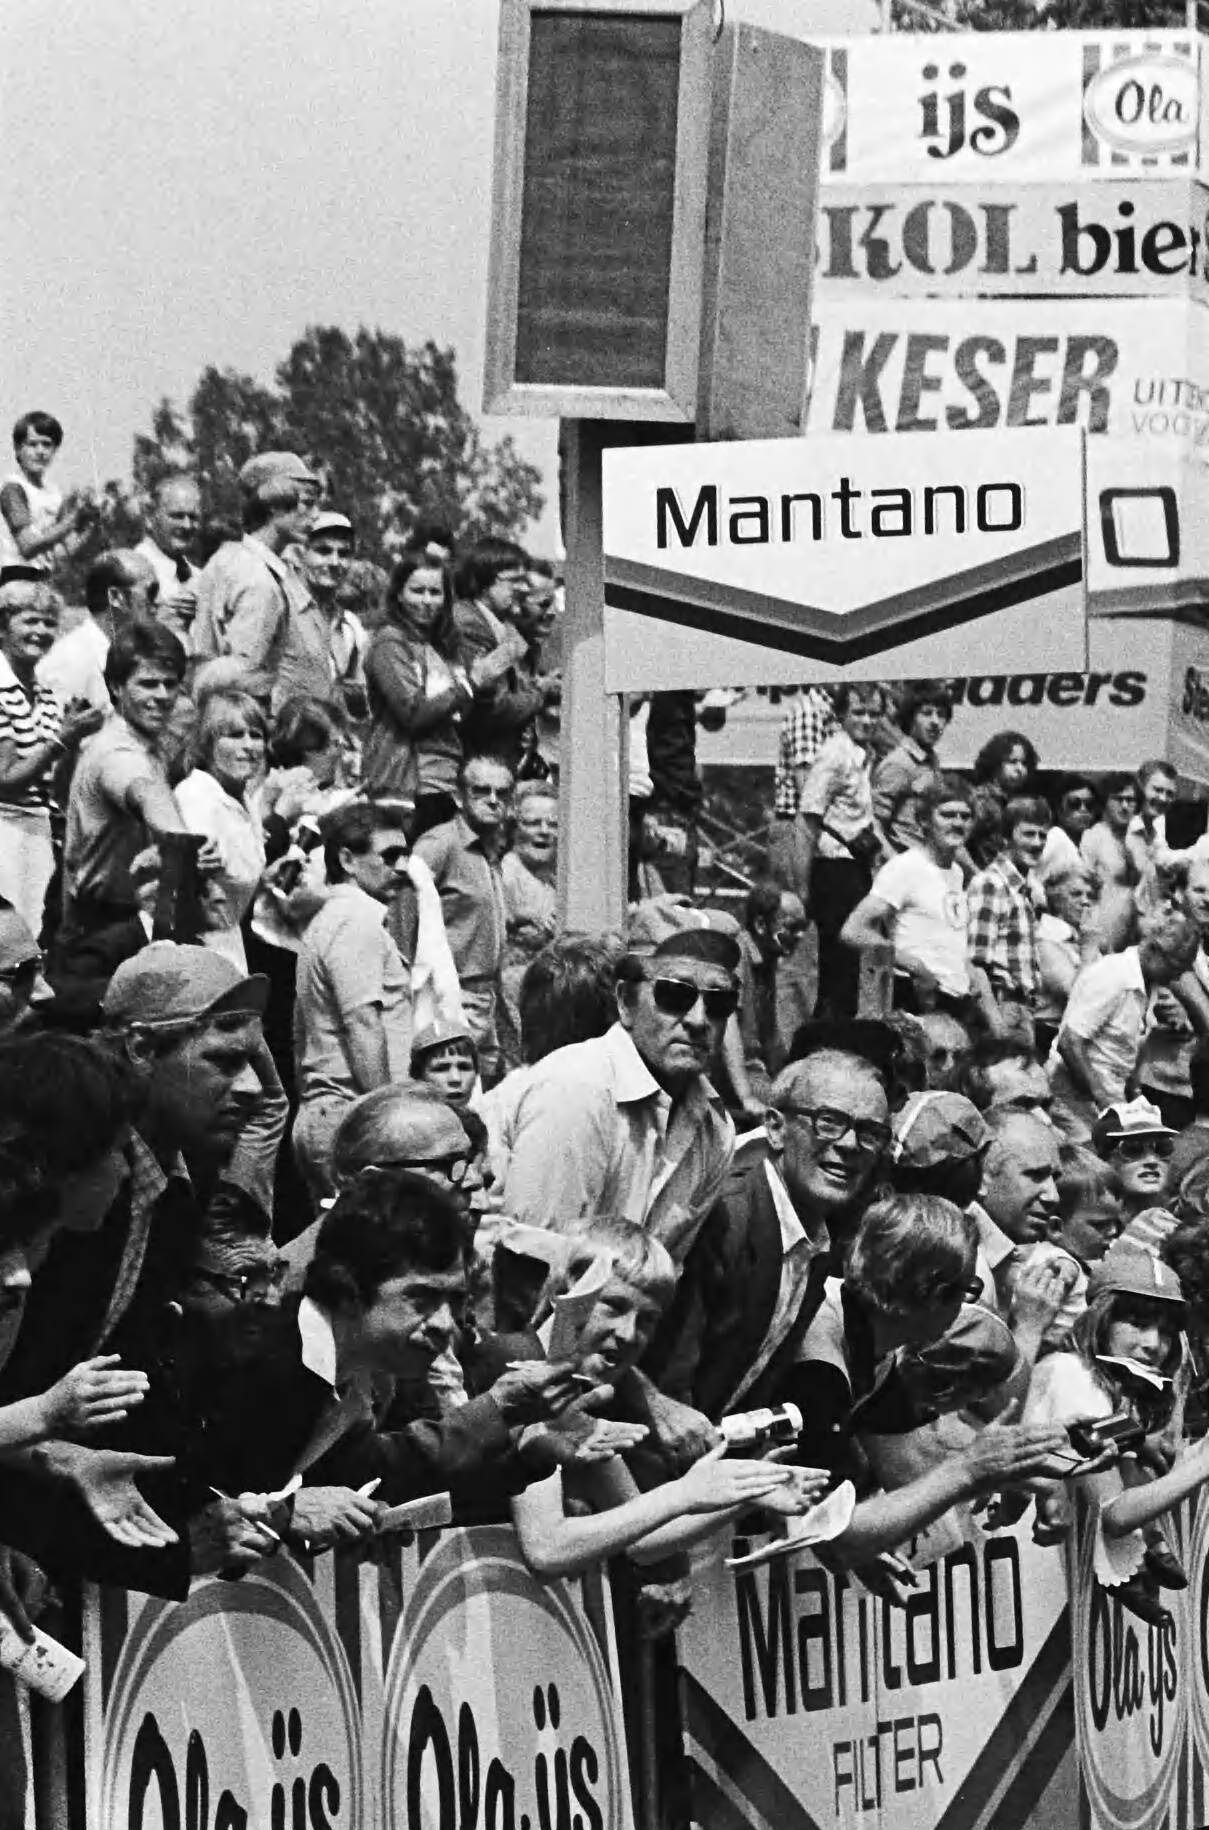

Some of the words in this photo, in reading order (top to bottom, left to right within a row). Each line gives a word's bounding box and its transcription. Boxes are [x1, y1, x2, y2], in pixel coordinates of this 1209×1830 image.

[918, 62, 1020, 158] ijs
[1115, 79, 1190, 124] Ola
[813, 200, 1038, 281] KOL
[1056, 199, 1200, 278] bier
[832, 329, 1119, 434] KESER
[656, 477, 1023, 549] Mantano
[832, 1712, 944, 1817] FILTER
